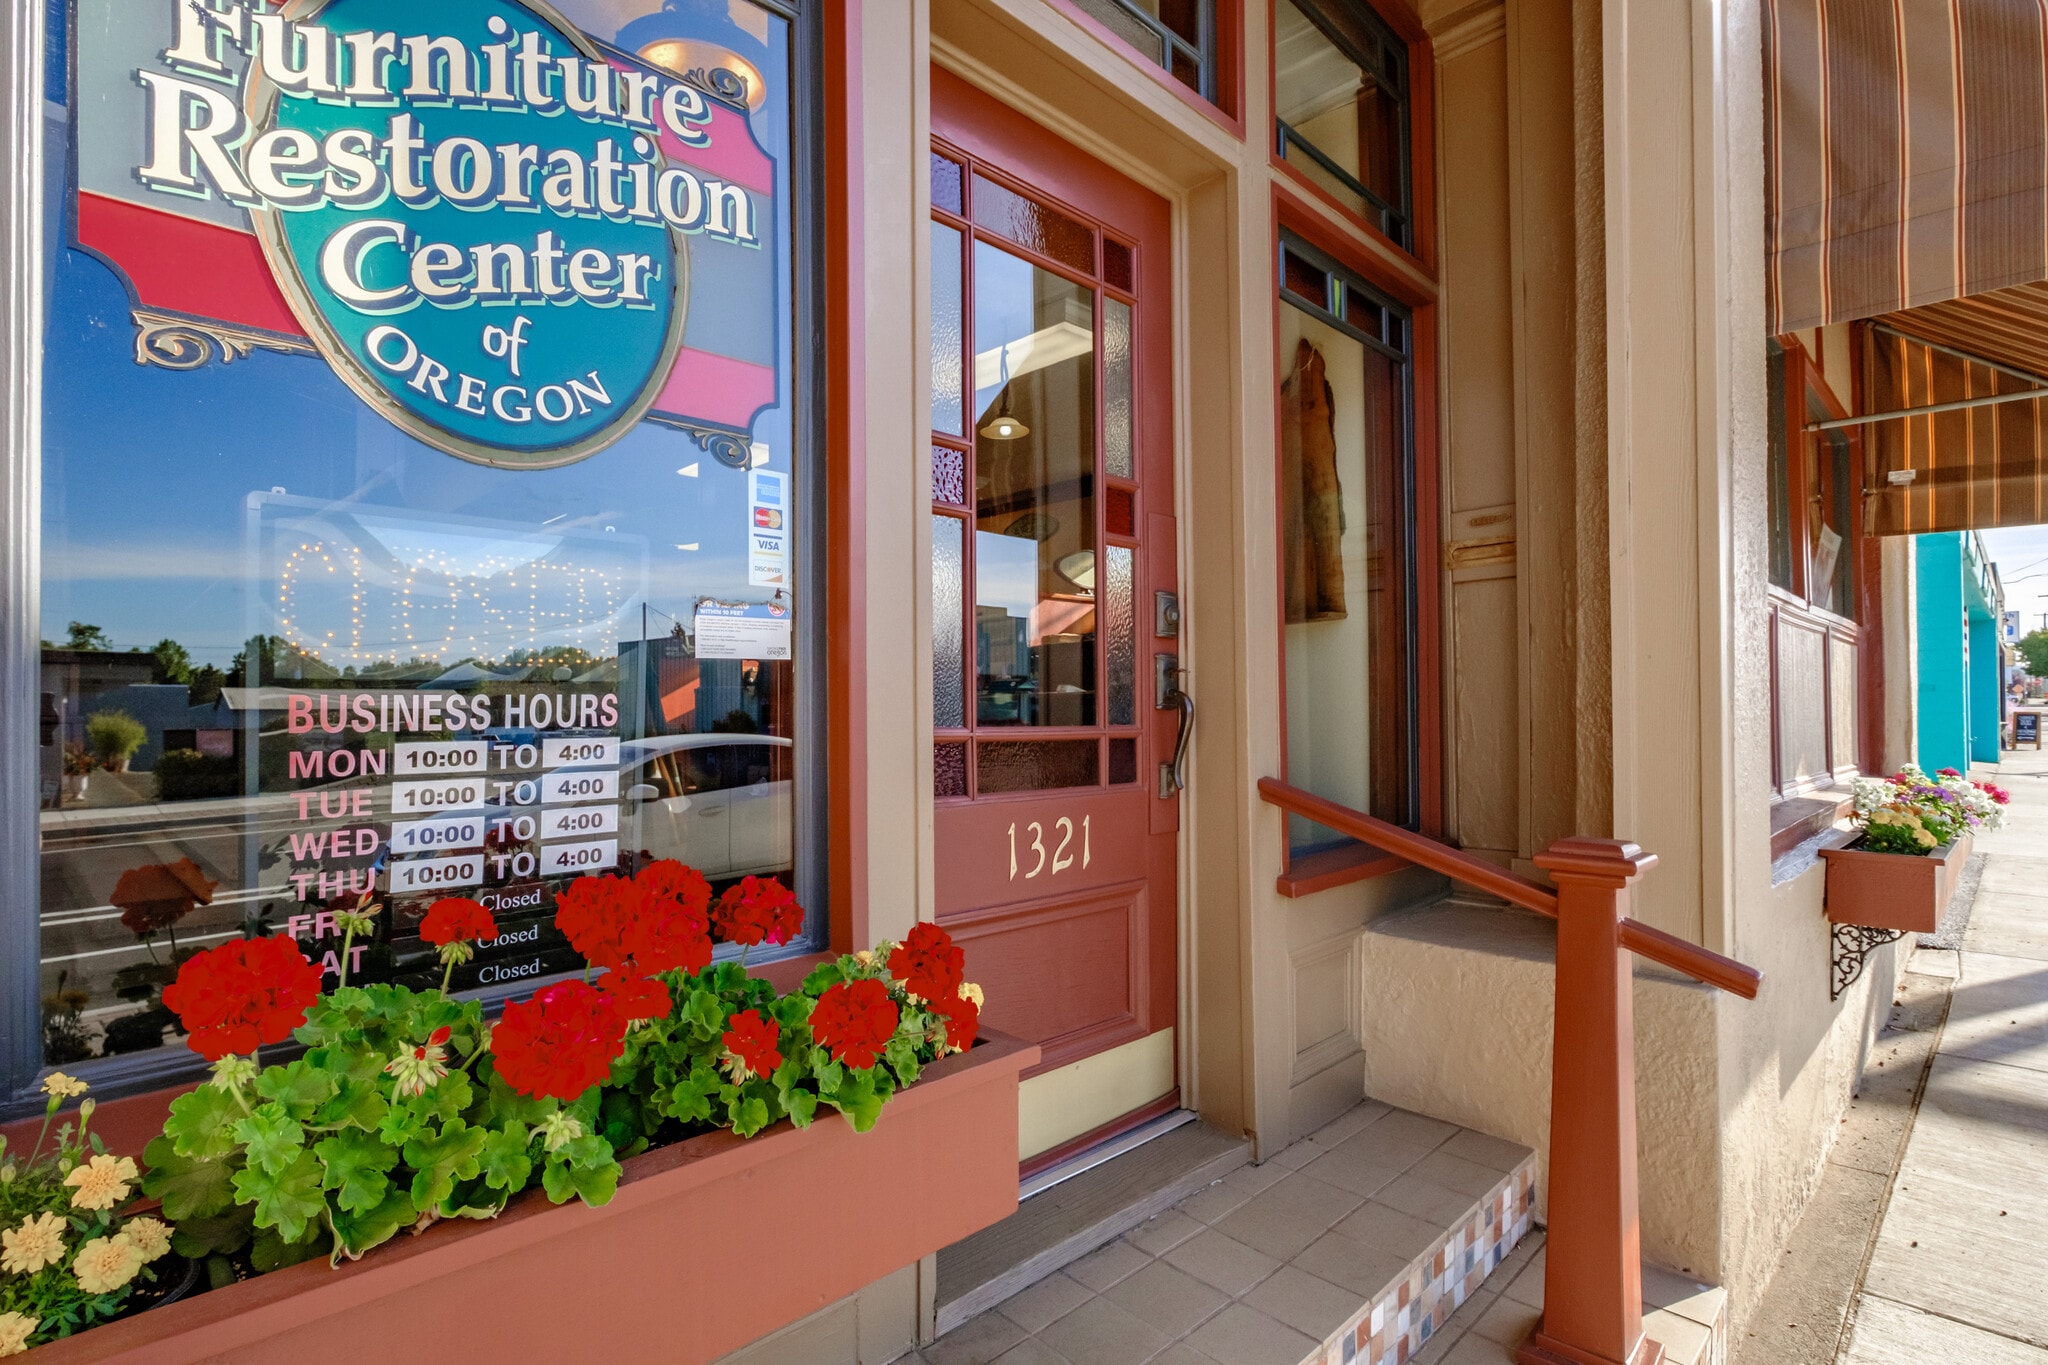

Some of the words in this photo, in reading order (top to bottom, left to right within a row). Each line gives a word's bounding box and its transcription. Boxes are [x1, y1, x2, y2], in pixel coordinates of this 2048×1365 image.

[164, 0, 706, 140] Furniture
[137, 69, 758, 243] Restoration
[321, 219, 657, 304] Center
[482, 316, 533, 377] of
[365, 325, 613, 422] OREGON
[754, 565, 782, 574] DISCOVER
[757, 540, 780, 552] VISA
[288, 693, 492, 734] BUSINESS
[505, 693, 619, 729] HOURS
[288, 747, 386, 780] MON
[406, 749, 478, 769] 10:00
[493, 743, 539, 770] TO
[558, 741, 606, 761] 4:00
[289, 788, 374, 821] TUE
[403, 786, 476, 807] 10:00
[493, 779, 537, 806] TO
[557, 777, 604, 796] 4:00
[289, 827, 380, 862] WED
[403, 823, 475, 846] 10:00
[492, 815, 536, 843] TO
[556, 812, 604, 831] 4:00
[1007, 813, 1091, 883] 1321
[289, 867, 376, 903] THU
[402, 861, 474, 885] 10:00
[491, 852, 535, 880] TO
[556, 847, 603, 867] 4:00
[288, 909, 355, 942] FR
[480, 888, 541, 911] Closed
[302, 945, 368, 979] AT
[479, 958, 540, 983] Closed
